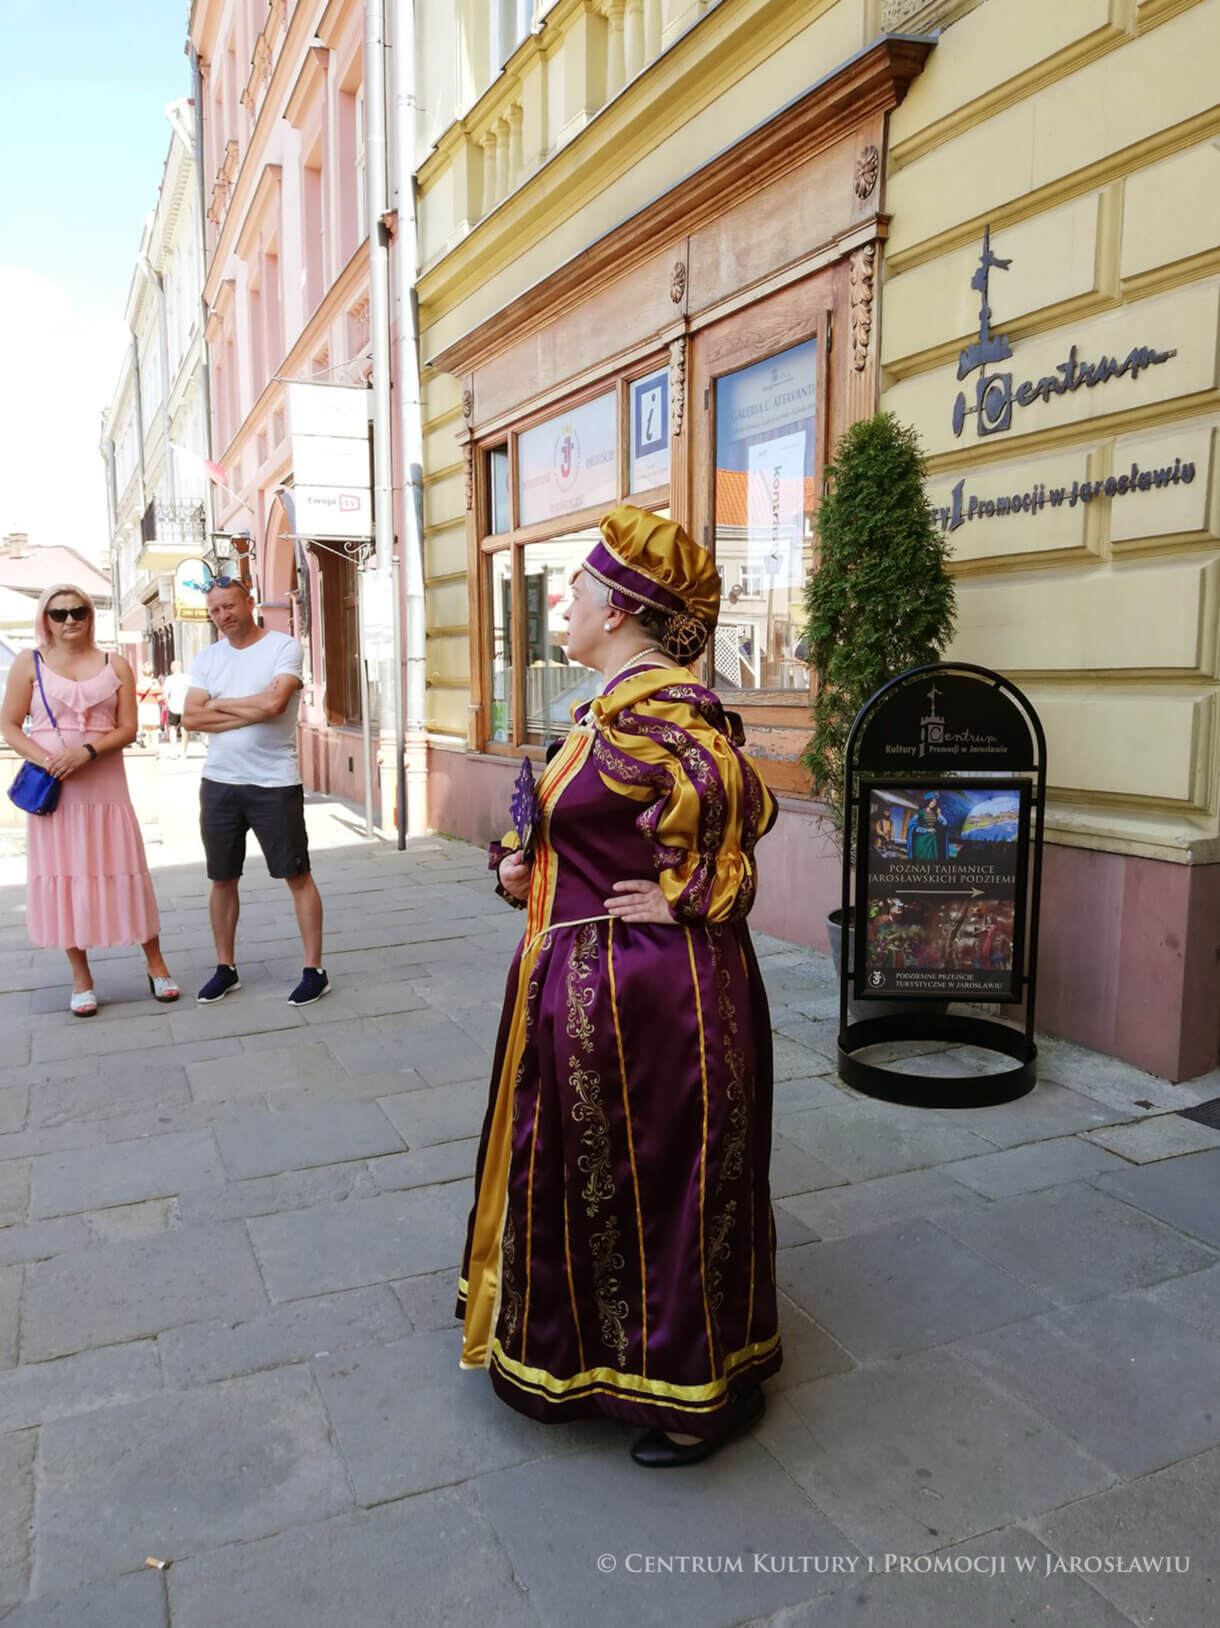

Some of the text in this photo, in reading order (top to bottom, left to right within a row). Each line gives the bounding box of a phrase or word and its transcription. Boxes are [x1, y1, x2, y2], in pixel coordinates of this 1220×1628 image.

[976, 345, 1178, 436] Centrum
[968, 483, 1045, 521] Promocji
[1050, 486, 1065, 507] w
[1068, 456, 1196, 507] Jarosławiu
[928, 723, 998, 743] Centrum
[885, 743, 917, 756] Kultury
[928, 744, 960, 754] Promocji
[969, 744, 1008, 753] Jarosławiu
[889, 864, 995, 875] POZNAJ TAJEMNICE
[868, 873, 1016, 884] JAROSŁAWSKICH PODZIEMI
[895, 972, 974, 981] PODZIEMNE PRZEJŚCIE
[895, 980, 946, 988] TURYSTYCZNE
[956, 981, 1002, 989] JAROSŁAWIU
